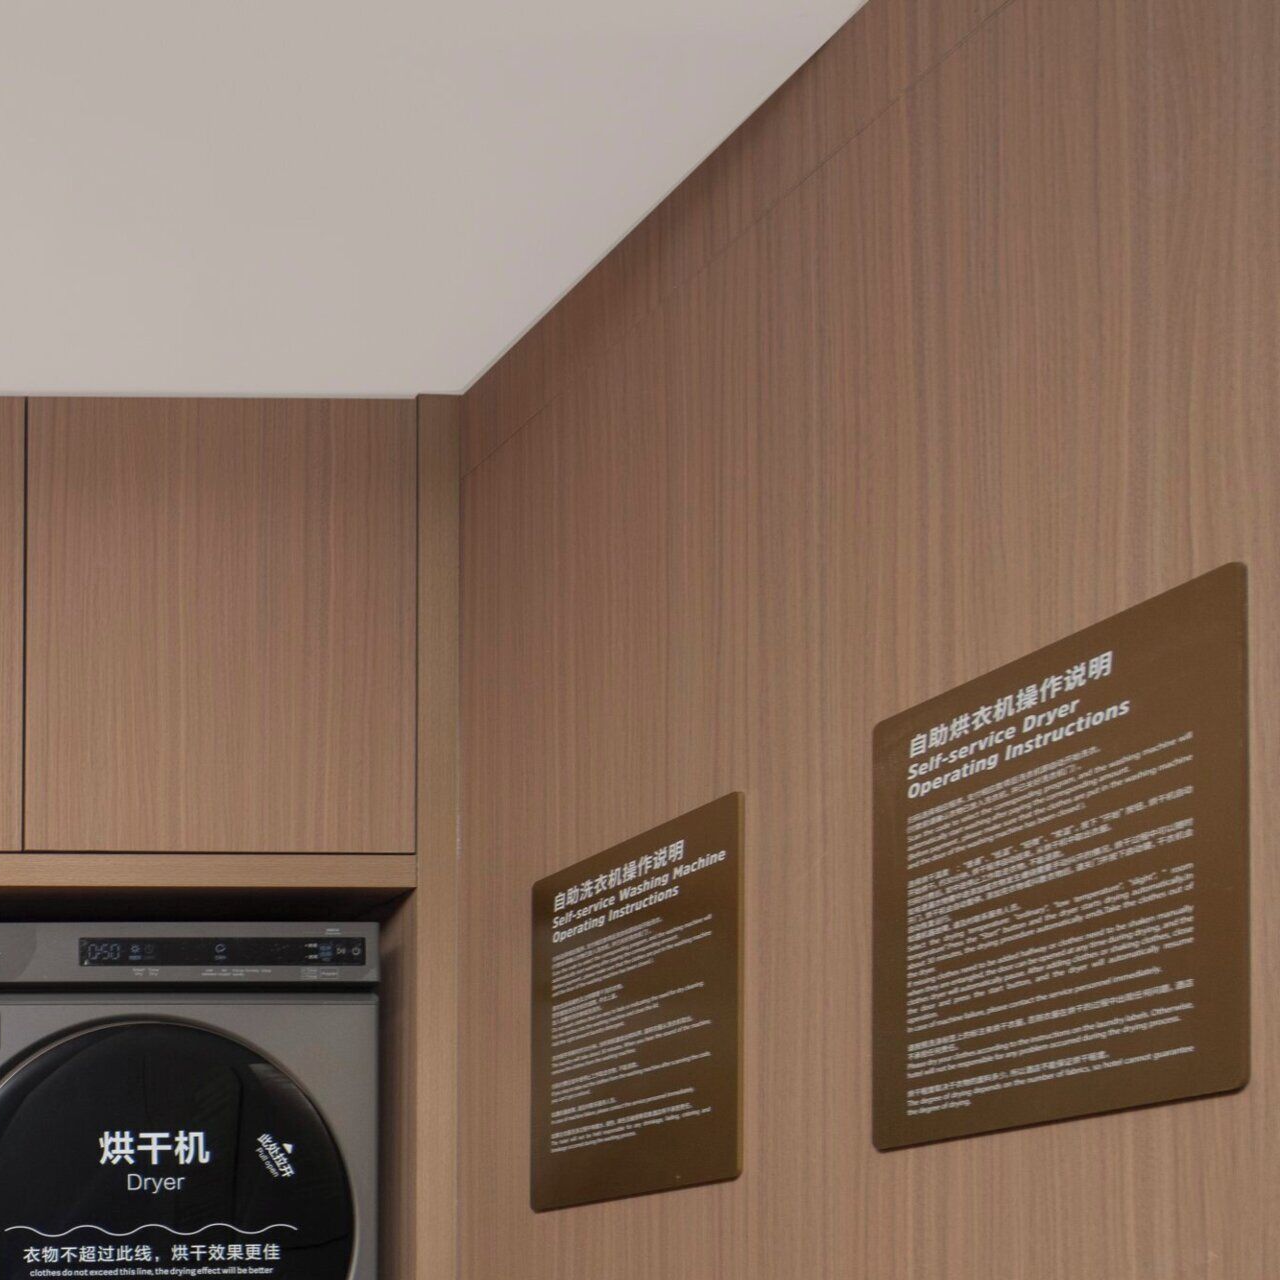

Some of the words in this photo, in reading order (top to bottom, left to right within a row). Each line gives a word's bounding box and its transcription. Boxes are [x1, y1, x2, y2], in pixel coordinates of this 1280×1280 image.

[909, 651, 1113, 758] 自助烘衣机操作说明
[907, 726, 1017, 780] Self-service
[1022, 699, 1080, 733] Dryer
[908, 753, 999, 799] Operating
[1004, 701, 1131, 760] Instructions
[552, 894, 615, 928] Self-service
[620, 873, 669, 901] Washing
[673, 850, 727, 879] Machine
[553, 839, 684, 912] 自助洗衣机操作说明
[552, 915, 605, 943] Operating
[608, 886, 679, 921] Instructions
[99, 1131, 210, 1164] 烘干机
[256, 1147, 267, 1162] Pull
[265, 1161, 278, 1177] open
[257, 1133, 294, 1177] 此处拉开
[128, 1174, 185, 1194] Dryer
[23, 1244, 280, 1263] 衣物不超过此线，烘干效果更佳
[29, 1268, 61, 1276] clothes
[61, 1268, 73, 1276] do
[119, 1267, 136, 1275] this
[136, 1267, 153, 1275] line,
[169, 1267, 196, 1276] drying
[196, 1266, 221, 1274] effect
